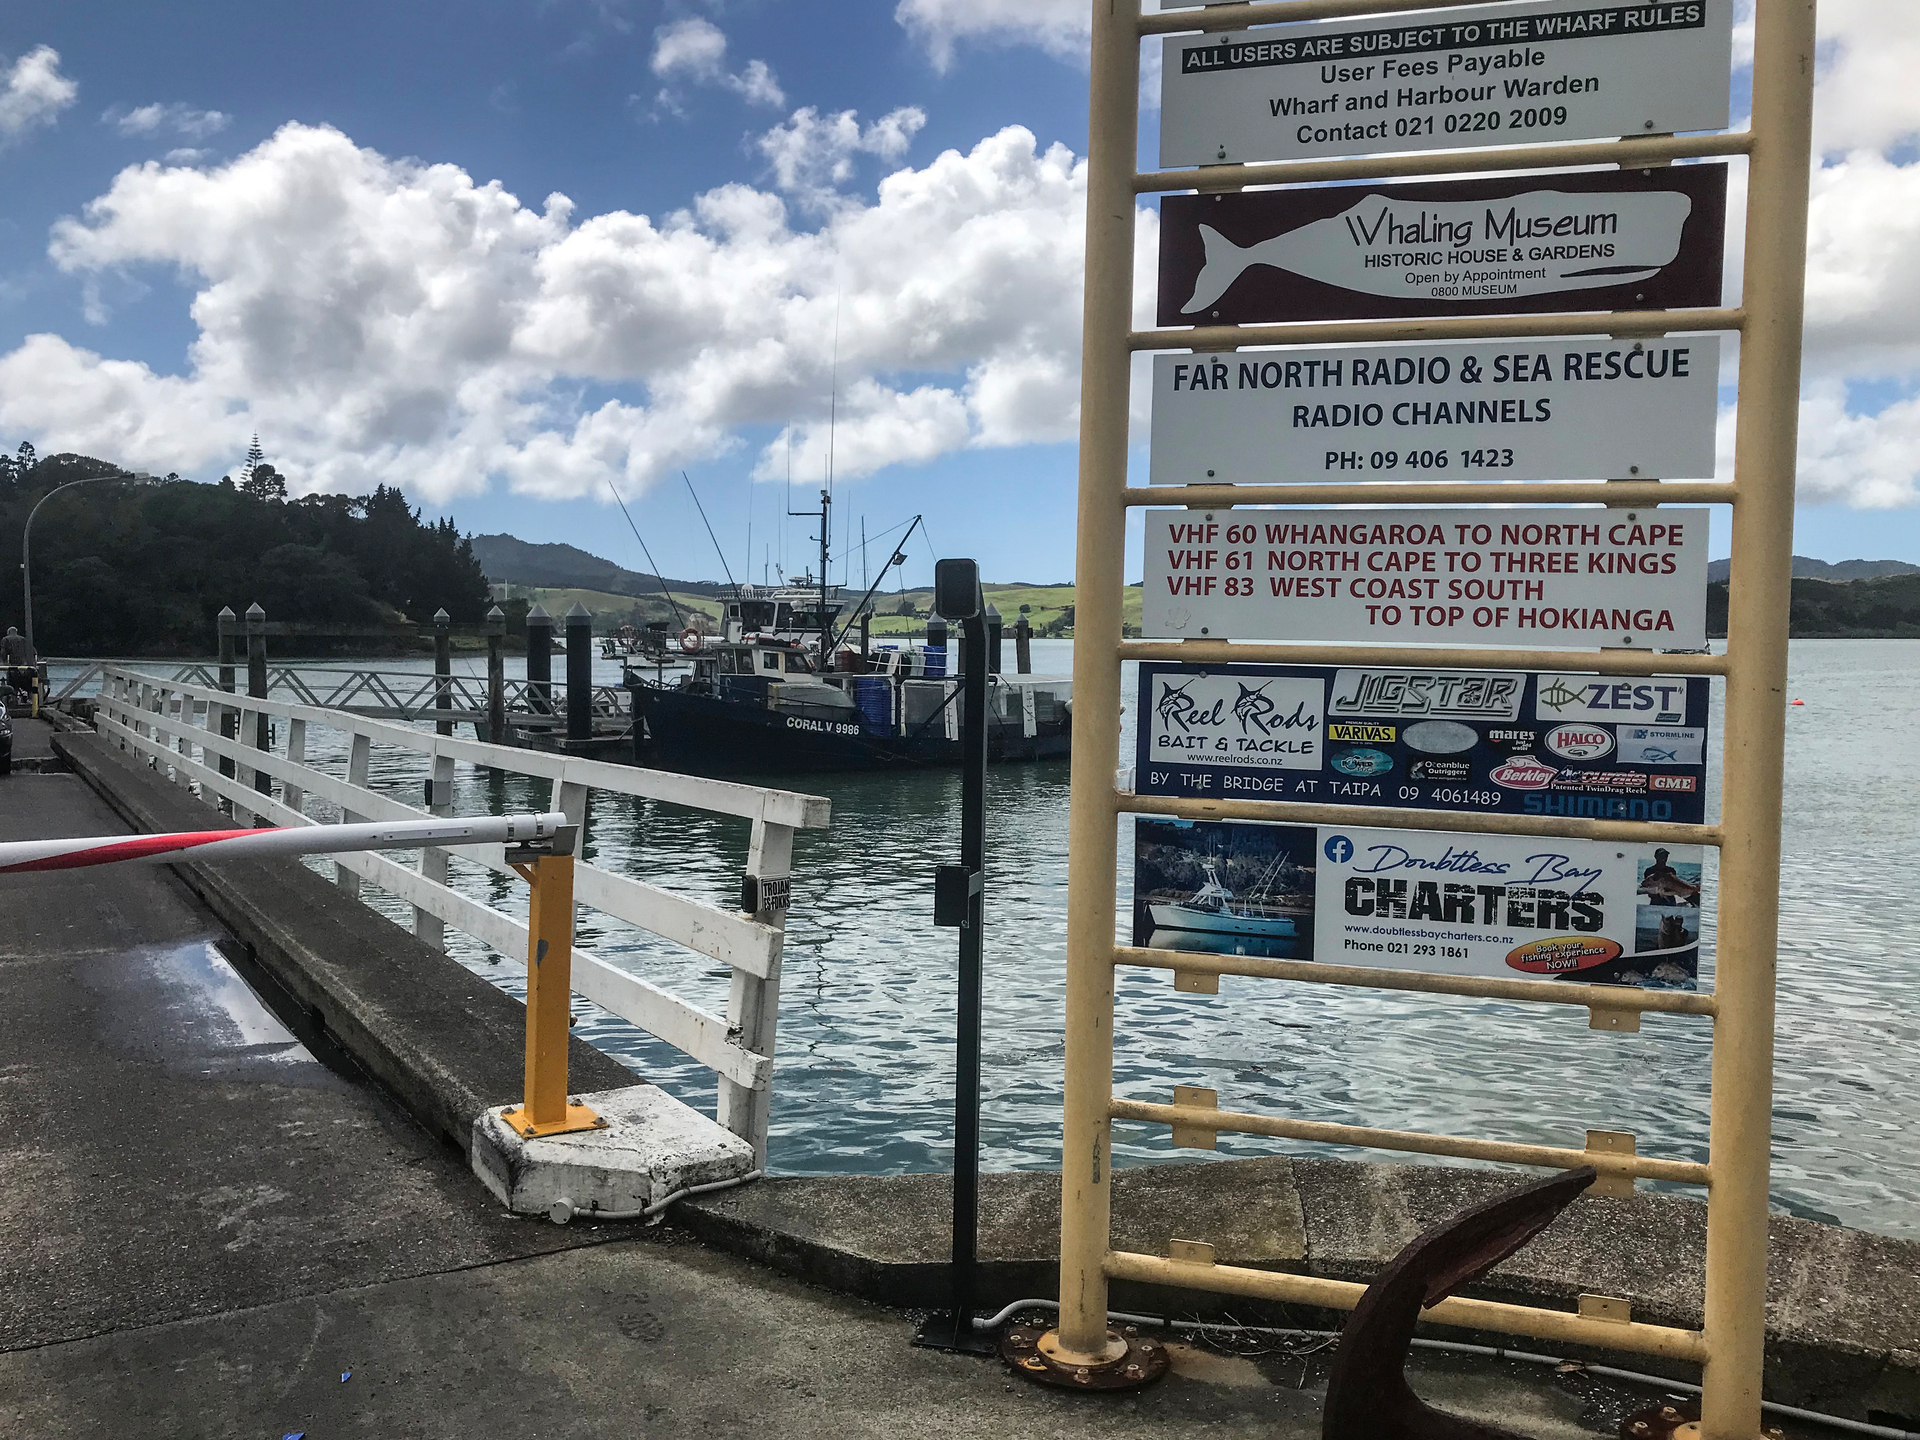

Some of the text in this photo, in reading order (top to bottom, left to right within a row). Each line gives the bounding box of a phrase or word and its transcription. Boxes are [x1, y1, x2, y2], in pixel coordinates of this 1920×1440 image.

[1187, 6, 1699, 68] ALL USERS ARE SUBJECT TO THE WHARF RULES
[1321, 48, 1545, 84] User Fees Payable
[1270, 75, 1599, 118] Wharf and Harbour Warden
[1298, 106, 1567, 145] Contact 021 0220 2009
[1346, 206, 1616, 248] Whaling Museum
[1364, 243, 1616, 268] HISTORIC HOUSE & GARDENS
[1405, 267, 1546, 286] Open by Appointment
[1431, 283, 1518, 297] 0800 MUSEUM
[1175, 348, 1690, 391] FAR NORTH RADIO & SEA RESCUE
[1293, 399, 1551, 428] RADIO CHANNELS
[1326, 448, 1514, 470] PH: 09 406 1423
[1169, 524, 1683, 546] VHF 60 WHANGAROA TO NORTH CAPE
[1168, 550, 1677, 575] VHF 61 NORTH CAPE TO THREE KINGS
[1167, 576, 1543, 600] VHF 83 WEST COAST SOUTH
[1366, 604, 1674, 631] TO TOP OF HOKIANGA
[1155, 678, 1319, 736] Reel Rods
[1586, 684, 1677, 711] ZEST
[787, 717, 859, 735] CORAL V 9986
[1489, 730, 1535, 740] mares
[1158, 735, 1314, 754] BAIT & TACKLE
[1557, 733, 1605, 748] HALCO
[1187, 753, 1282, 766] www.reelrods.co.nz
[1425, 761, 1470, 769] Oceanblue
[1500, 769, 1555, 783] Berkley
[1655, 777, 1691, 789] GME
[1150, 772, 1501, 806] BY THE BRIDGE AT TAIPA 09 4061489
[1586, 785, 1624, 794] TwinDrag
[1524, 794, 1672, 820] SHIMANO
[1353, 845, 1602, 900] Doubtless Bay
[764, 880, 790, 896] TROJAN
[1345, 876, 1604, 932] CHARTERS
[1345, 924, 1514, 945] www.doubtlessbaycharters.co.nz
[1345, 939, 1468, 959] Phone 021 293 1861
[1521, 947, 1605, 963] fishing experience
[1536, 942, 1583, 953] Book your
[1547, 959, 1577, 970] NOW!!
